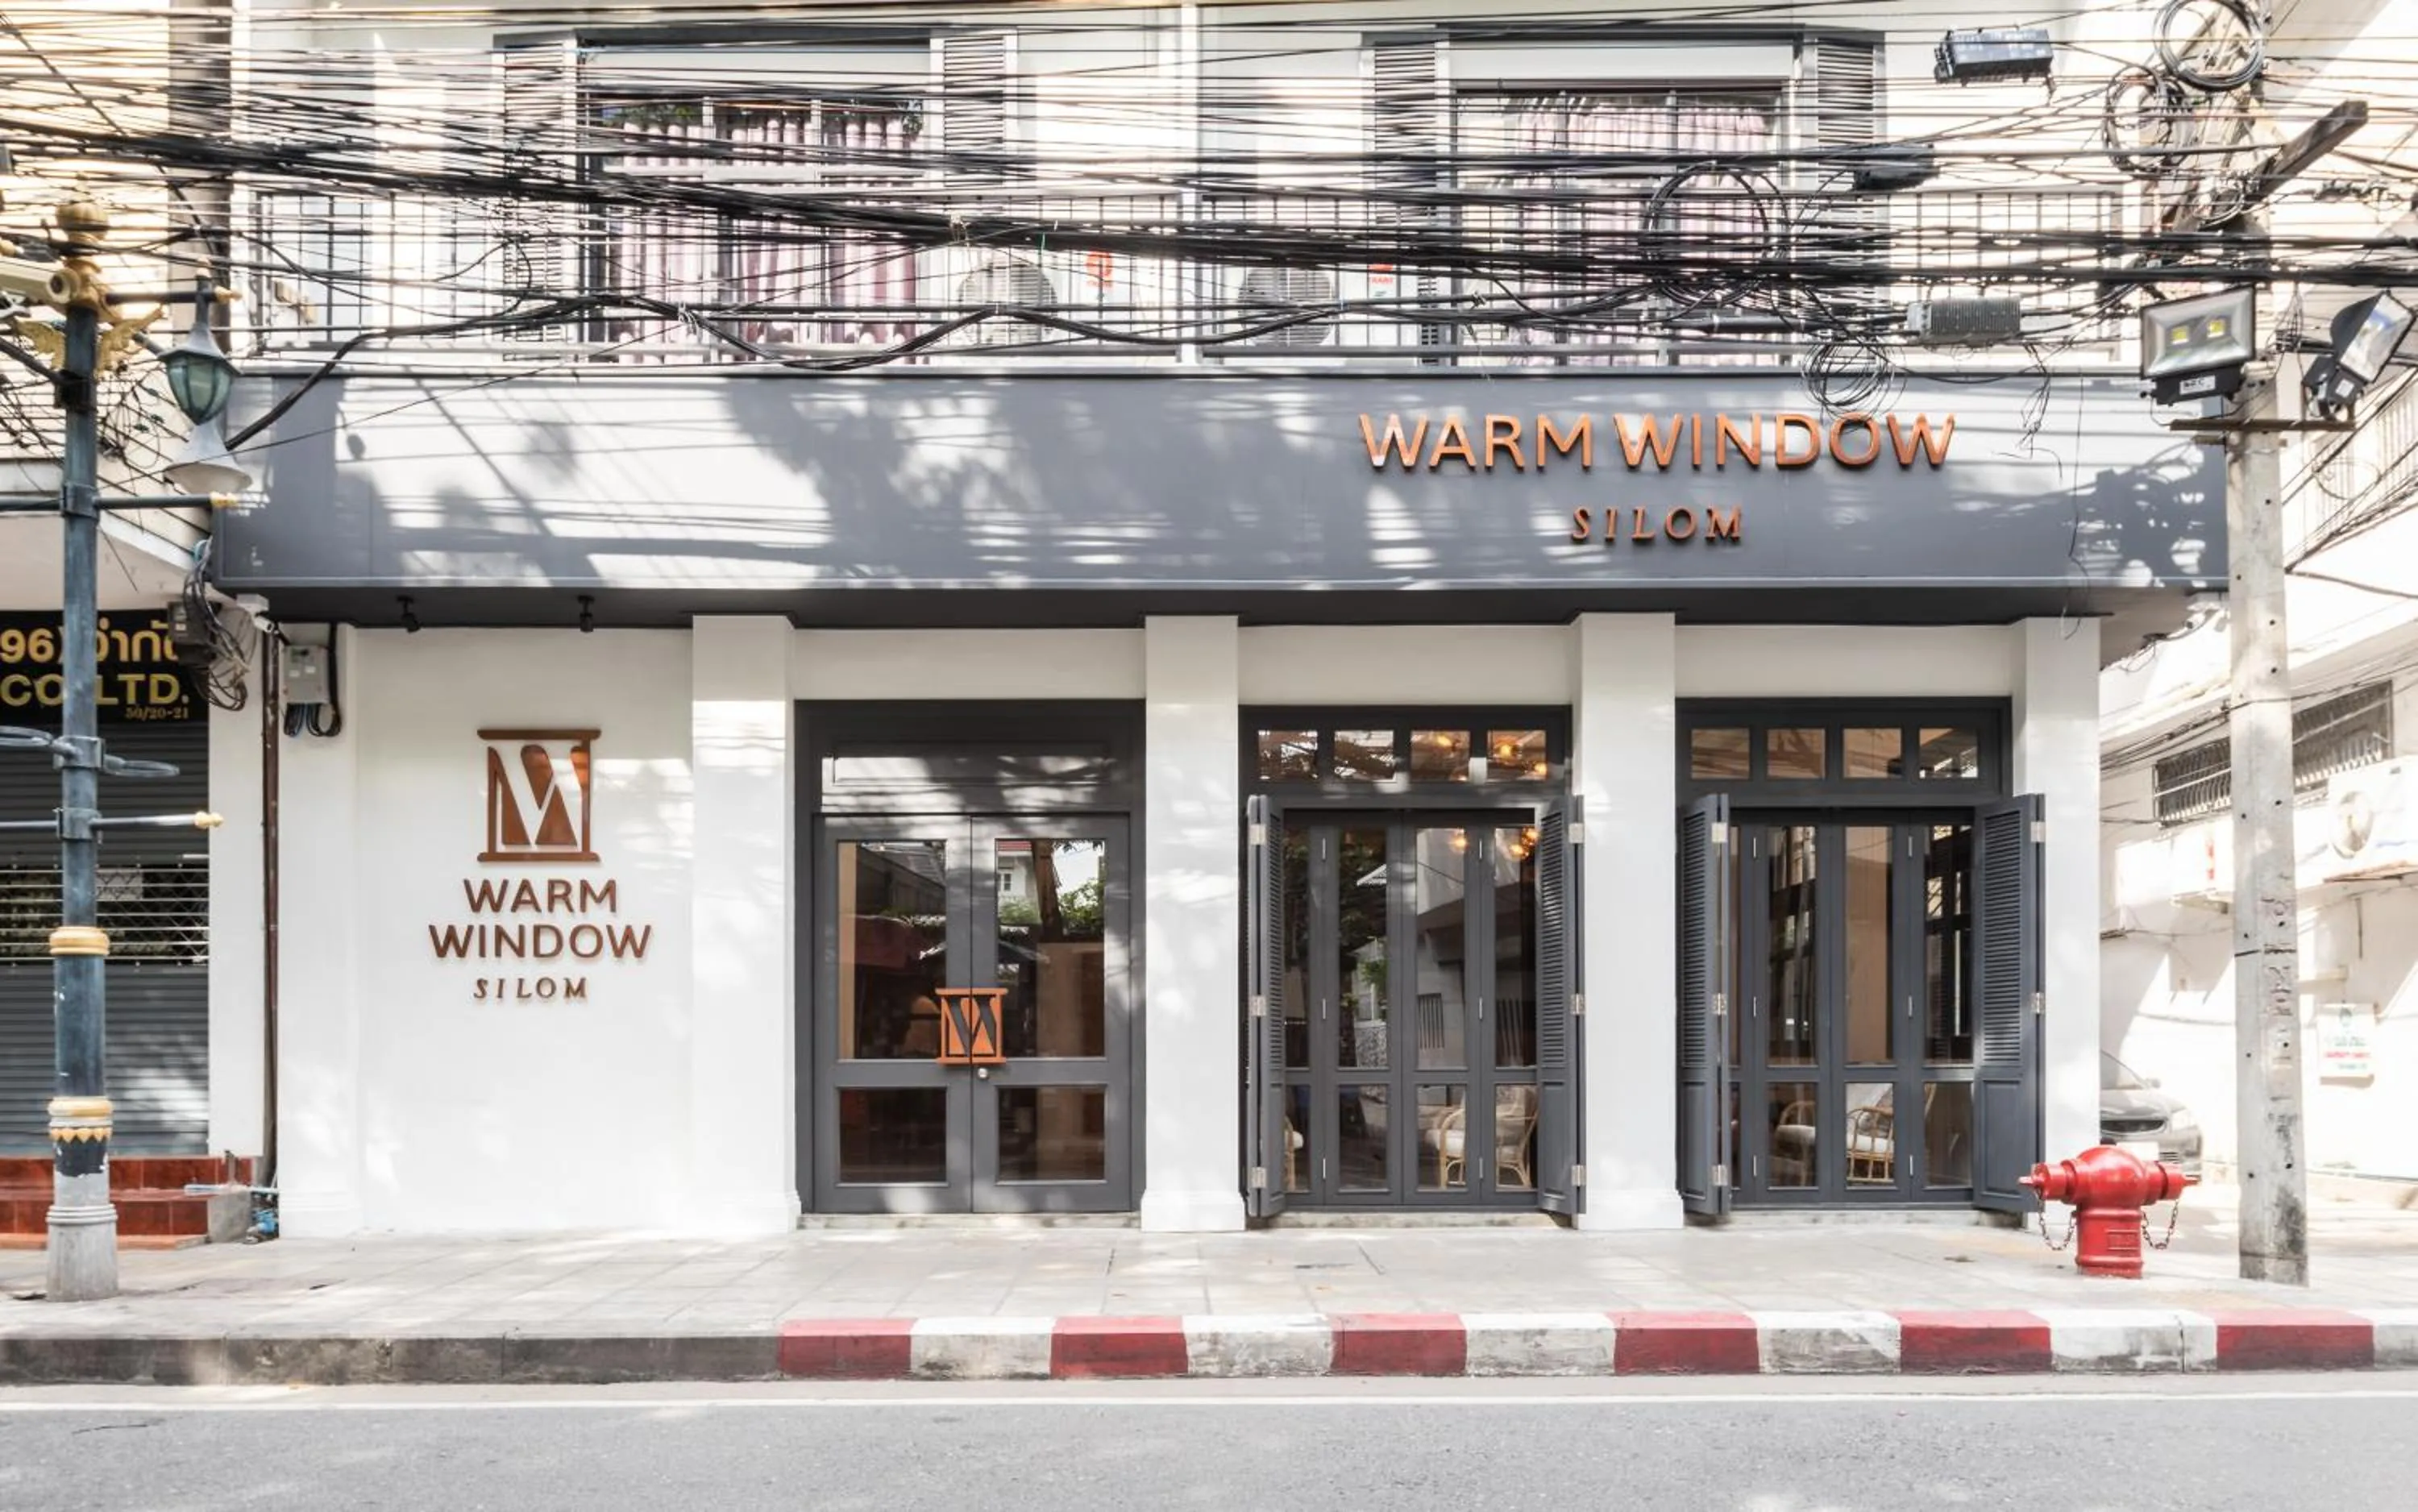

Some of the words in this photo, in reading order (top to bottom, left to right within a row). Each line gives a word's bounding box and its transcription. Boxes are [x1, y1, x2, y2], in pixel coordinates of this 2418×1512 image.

[1359, 413, 1593, 469] WARM
[1614, 412, 1955, 468] WINDOW
[1571, 505, 1743, 543] SILOM
[95, 673, 189, 706] LTD.
[463, 878, 617, 914] WARM
[428, 924, 652, 959] WINDOW
[473, 977, 588, 1000] SILOM
